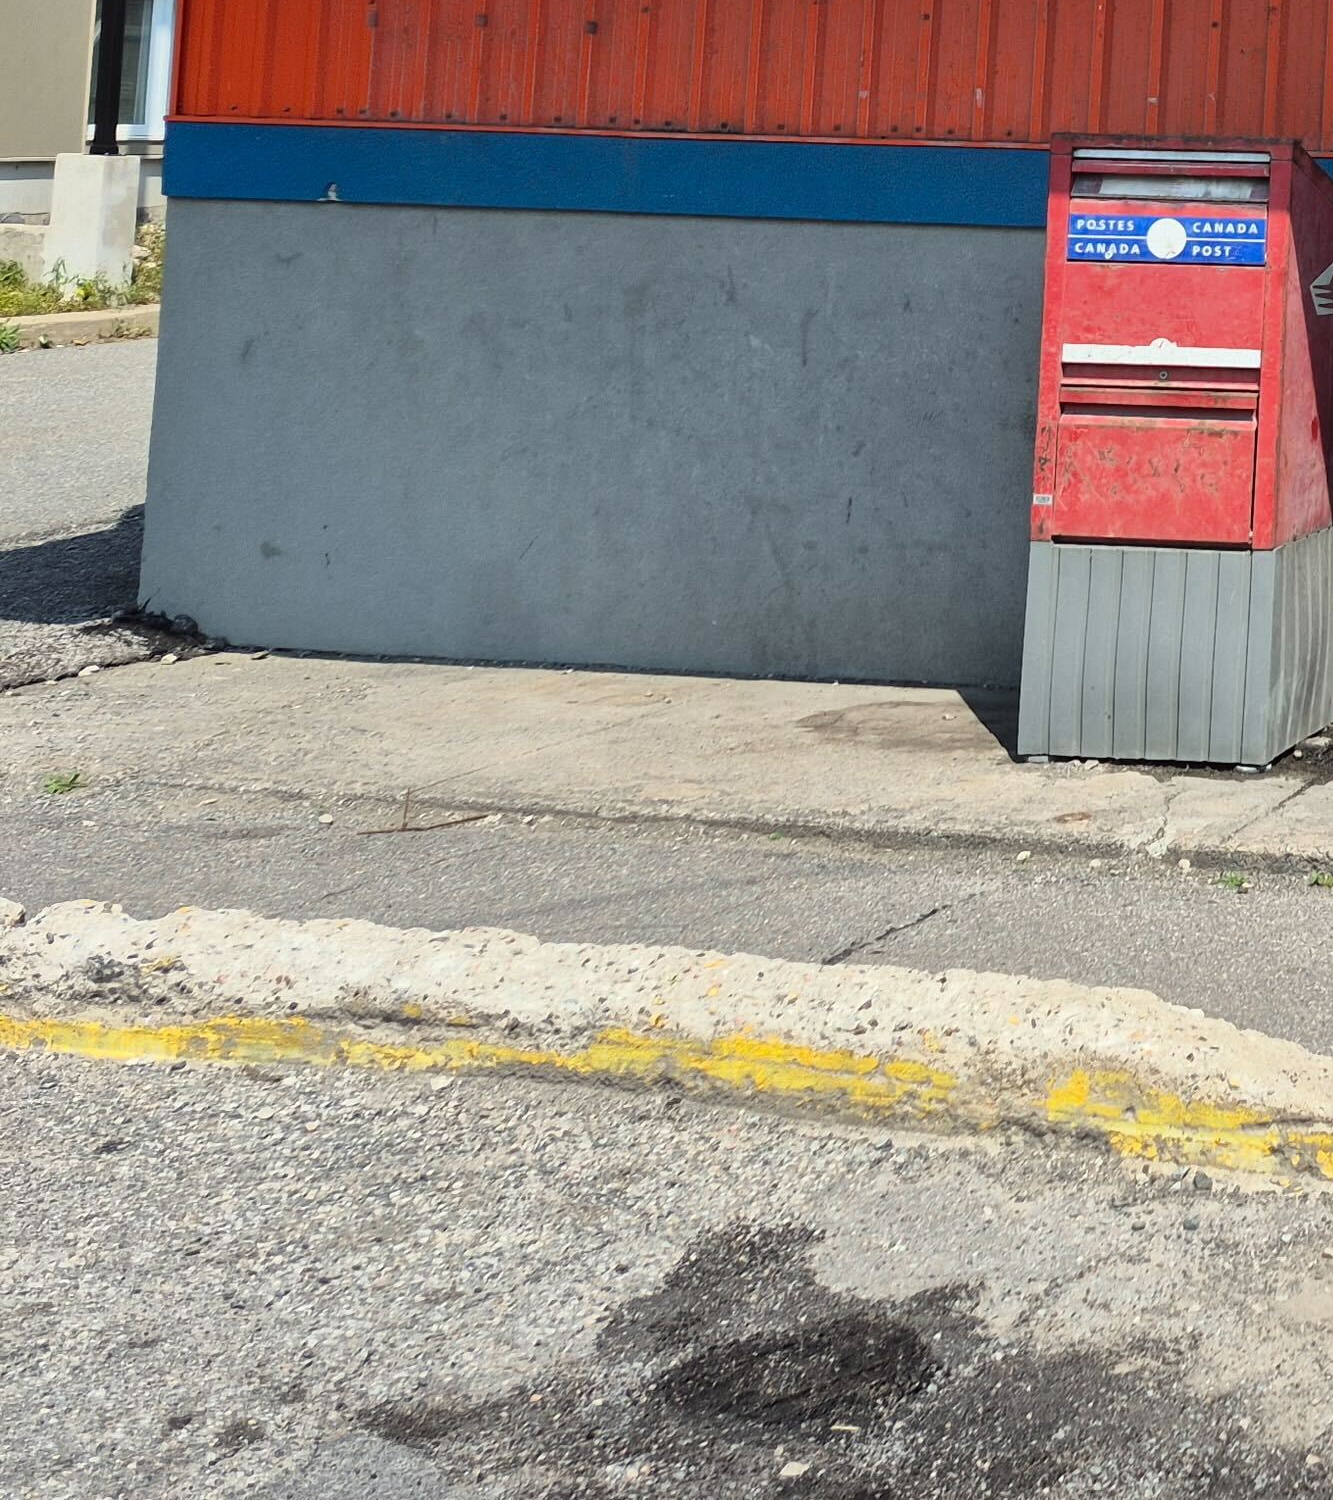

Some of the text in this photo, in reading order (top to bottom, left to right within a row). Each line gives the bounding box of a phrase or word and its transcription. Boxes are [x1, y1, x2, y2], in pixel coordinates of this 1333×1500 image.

[1076, 219, 1259, 235] POSTES CANADA
[1074, 242, 1232, 257] CANADA POST
